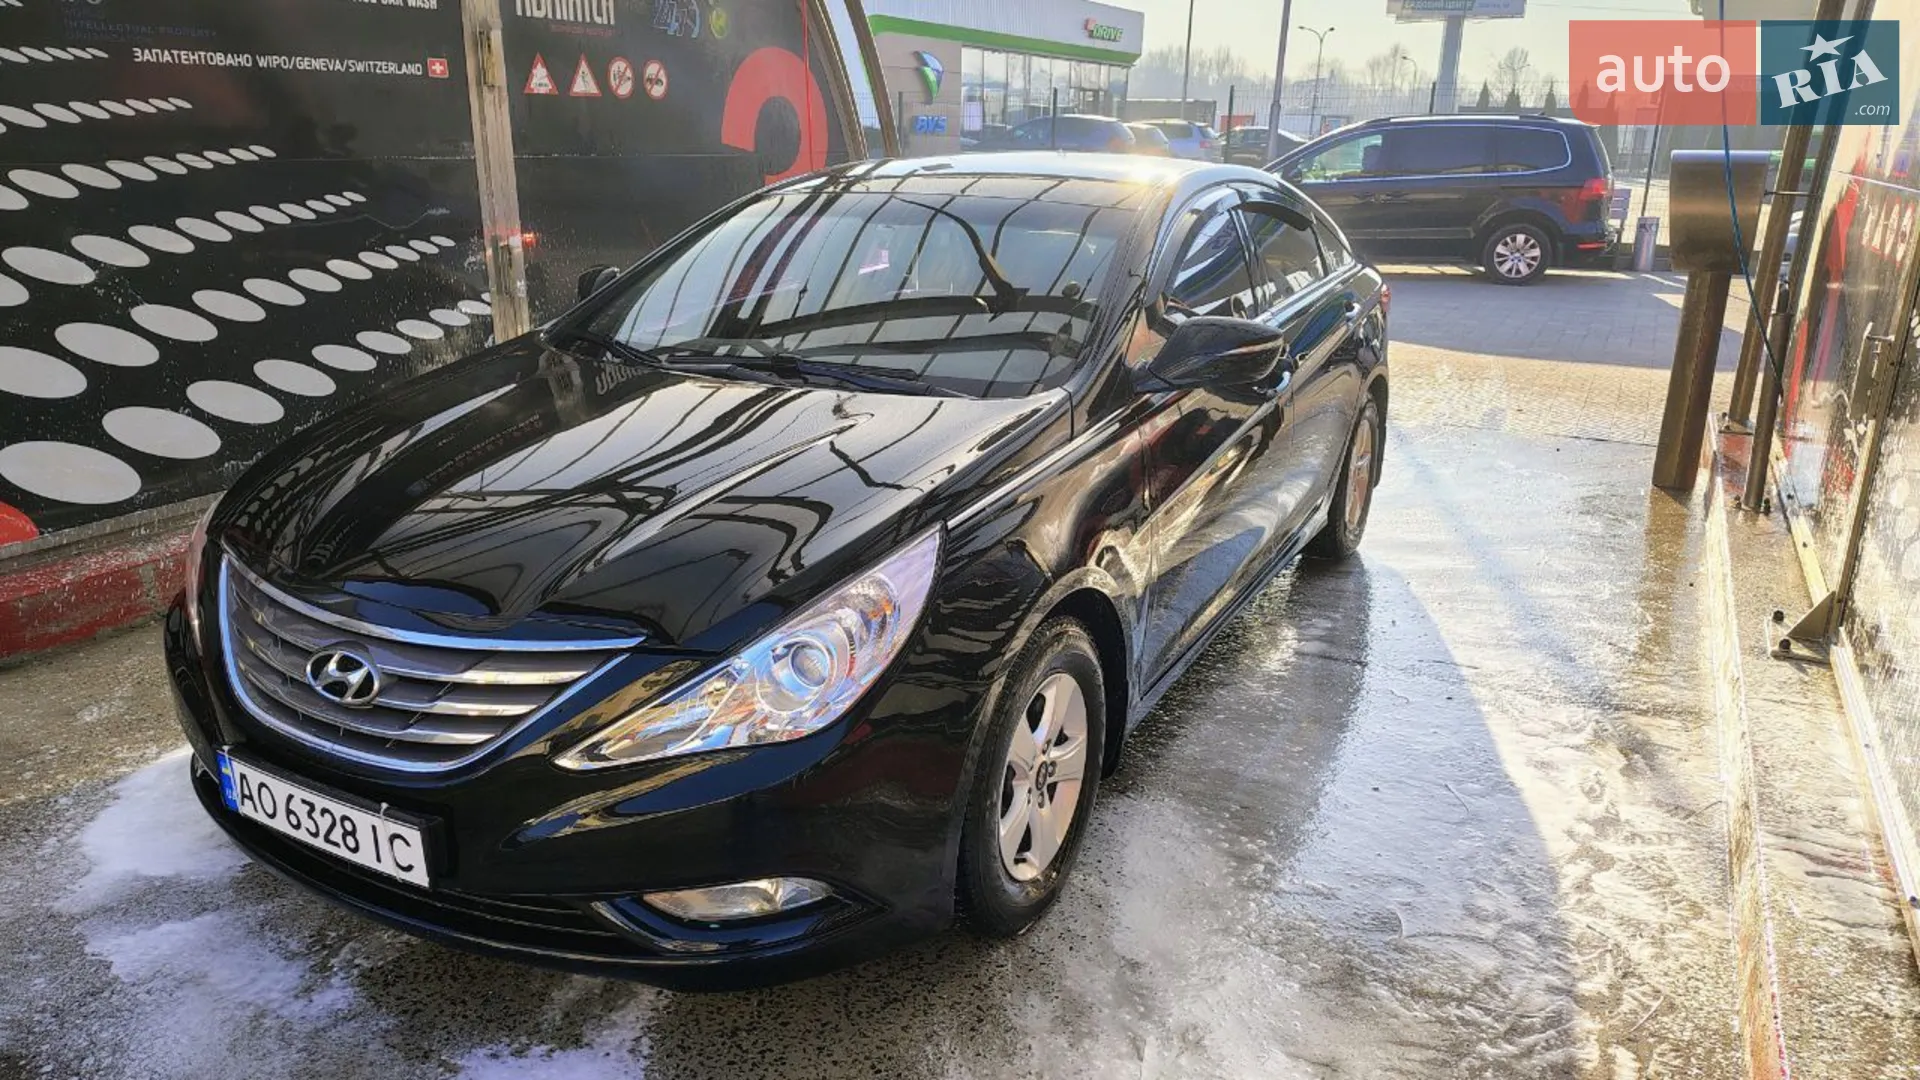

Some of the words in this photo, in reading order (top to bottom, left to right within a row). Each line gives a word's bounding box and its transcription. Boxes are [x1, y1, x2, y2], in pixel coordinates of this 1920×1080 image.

[132, 48, 252, 68] ЗАПАТЕНТОВАНО
[256, 55, 423, 76] WIPO/GENEVA/SWITZERLAND
[239, 772, 277, 819] AO
[285, 793, 360, 855] 6328
[371, 824, 415, 873] IC
